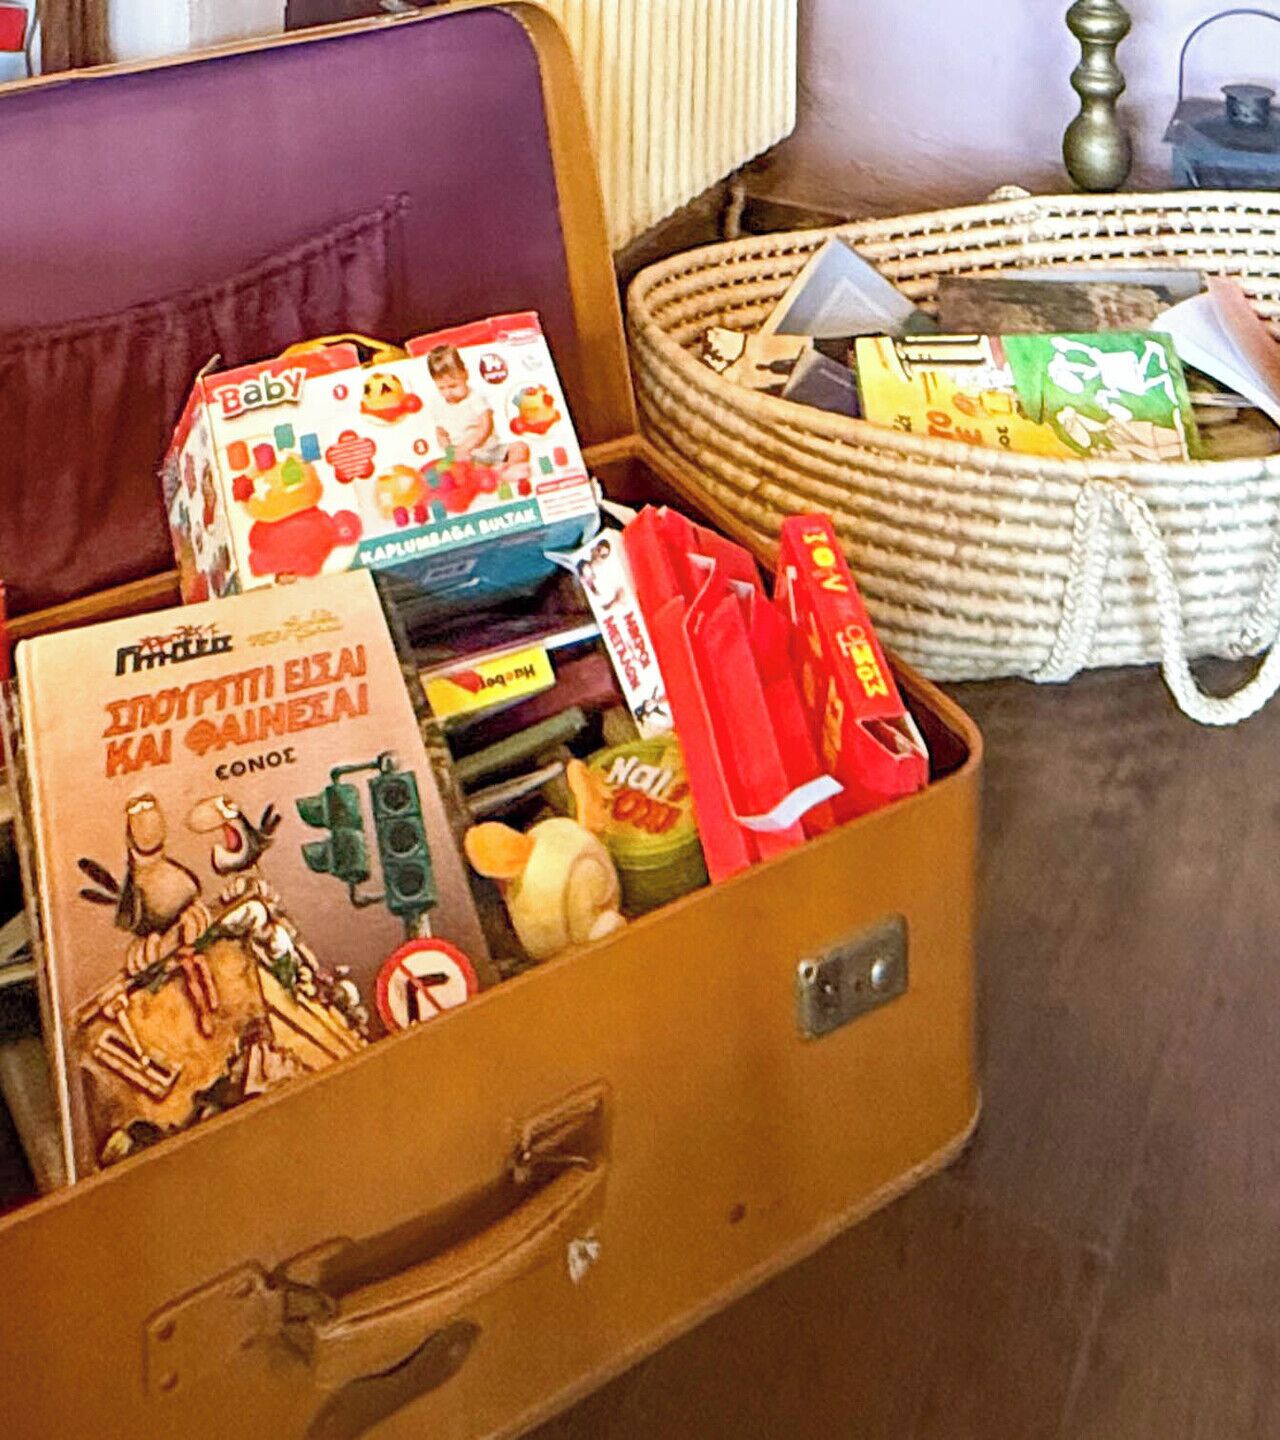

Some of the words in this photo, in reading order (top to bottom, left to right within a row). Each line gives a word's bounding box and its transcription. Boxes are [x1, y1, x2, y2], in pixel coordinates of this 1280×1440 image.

[218, 369, 304, 415] Baby
[284, 644, 368, 694] ΕΙΣΑΙ
[105, 729, 172, 778] ΚΑΙ
[184, 683, 369, 757] ΦΑΙΝΕΣΑΙ
